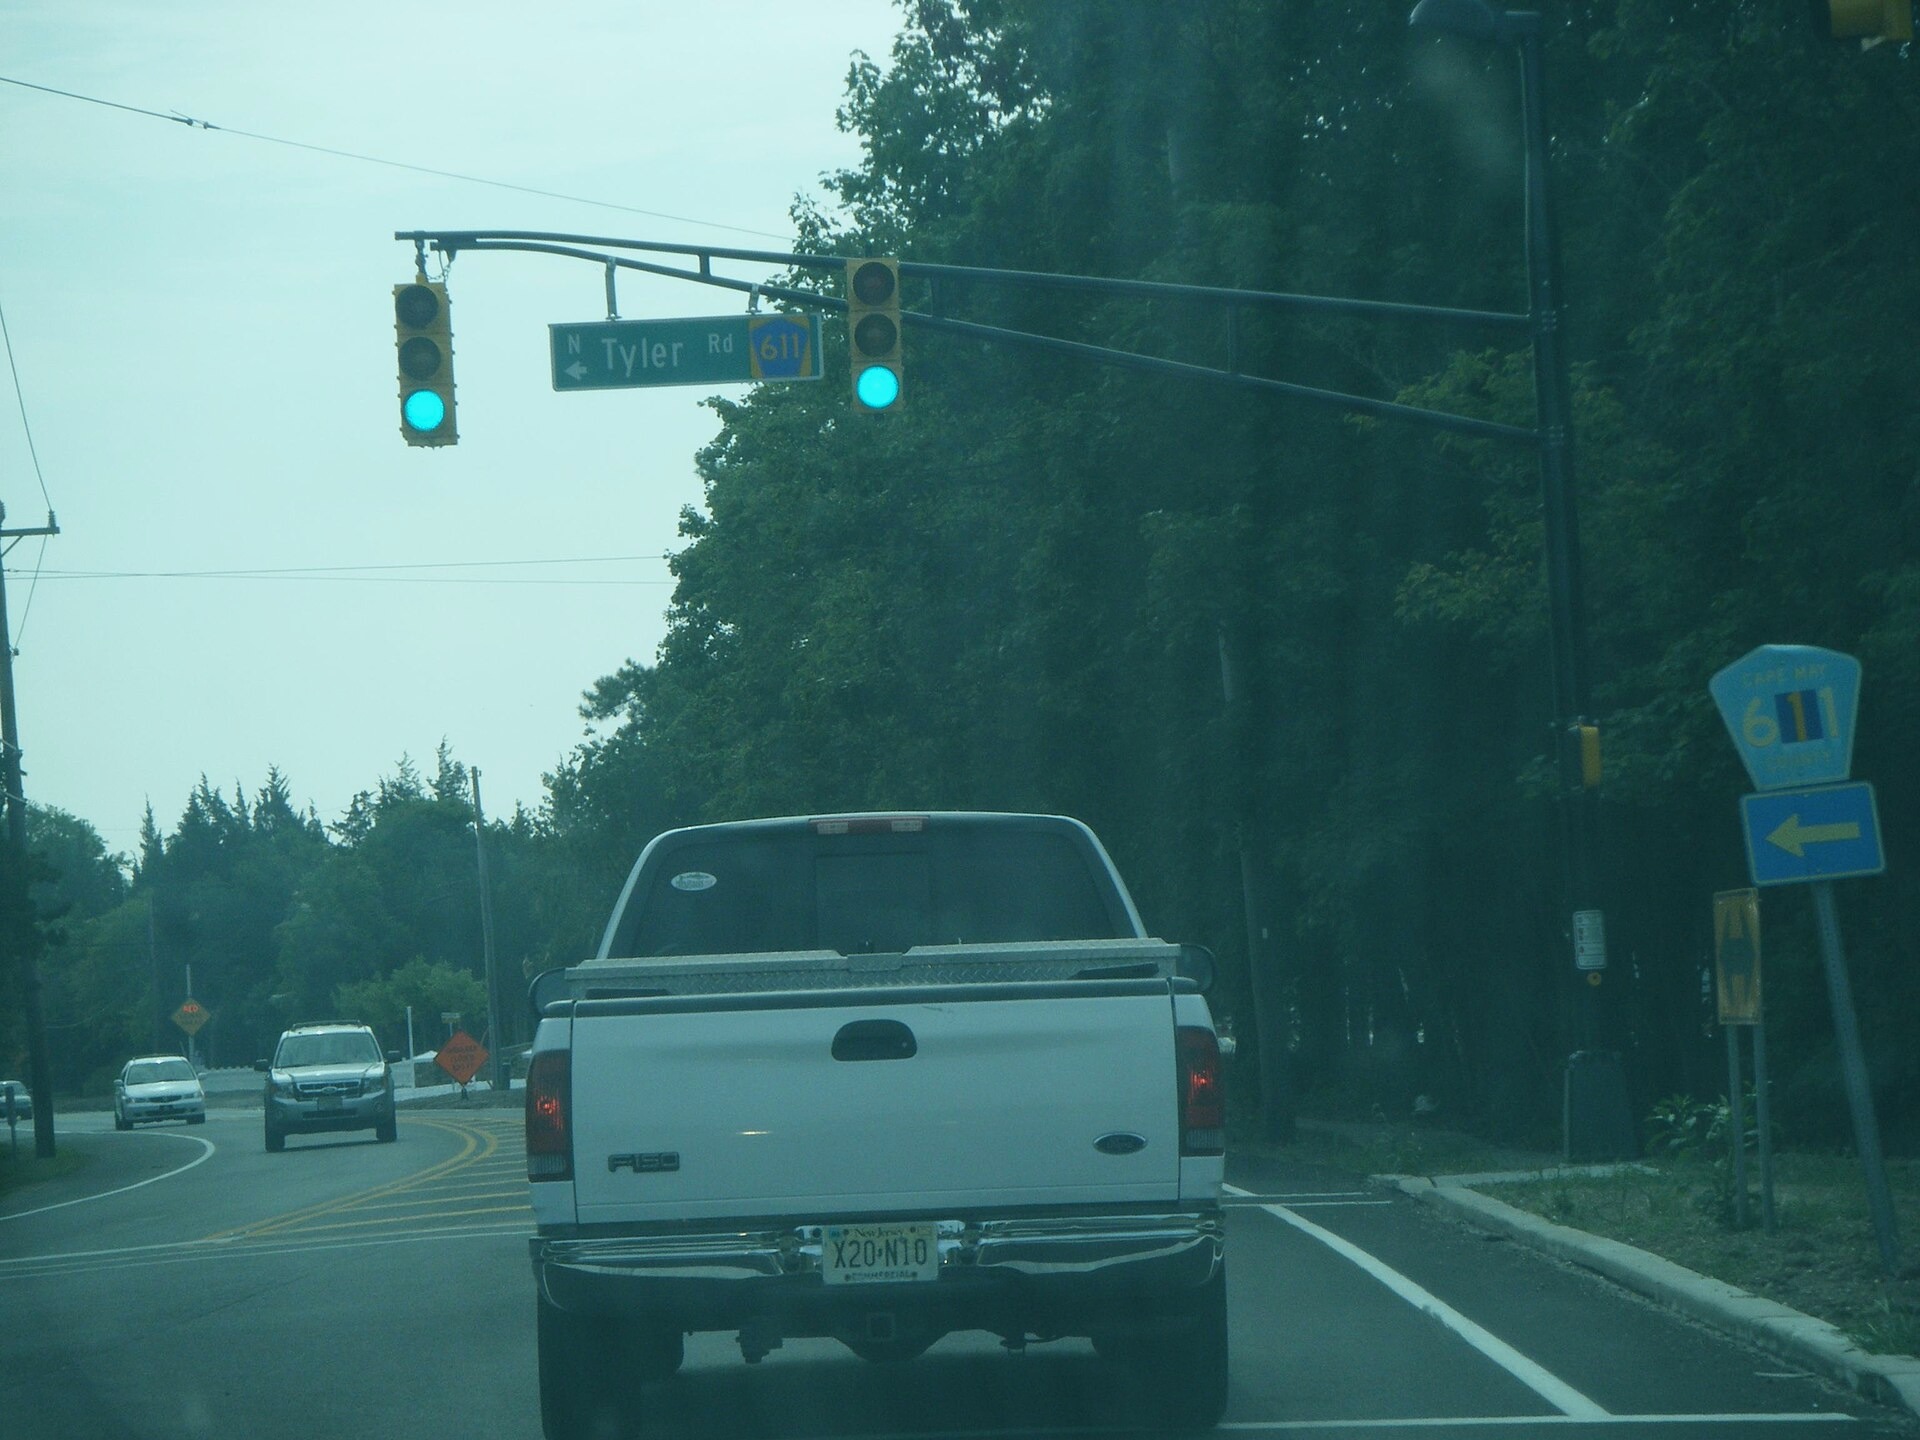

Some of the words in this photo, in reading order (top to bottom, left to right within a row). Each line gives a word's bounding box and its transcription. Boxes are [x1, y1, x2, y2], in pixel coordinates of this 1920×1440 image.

[567, 333, 581, 355] N
[601, 336, 684, 378] Tyler
[708, 333, 734, 354] Rd
[760, 332, 800, 362] 611
[1743, 686, 1839, 748] 611
